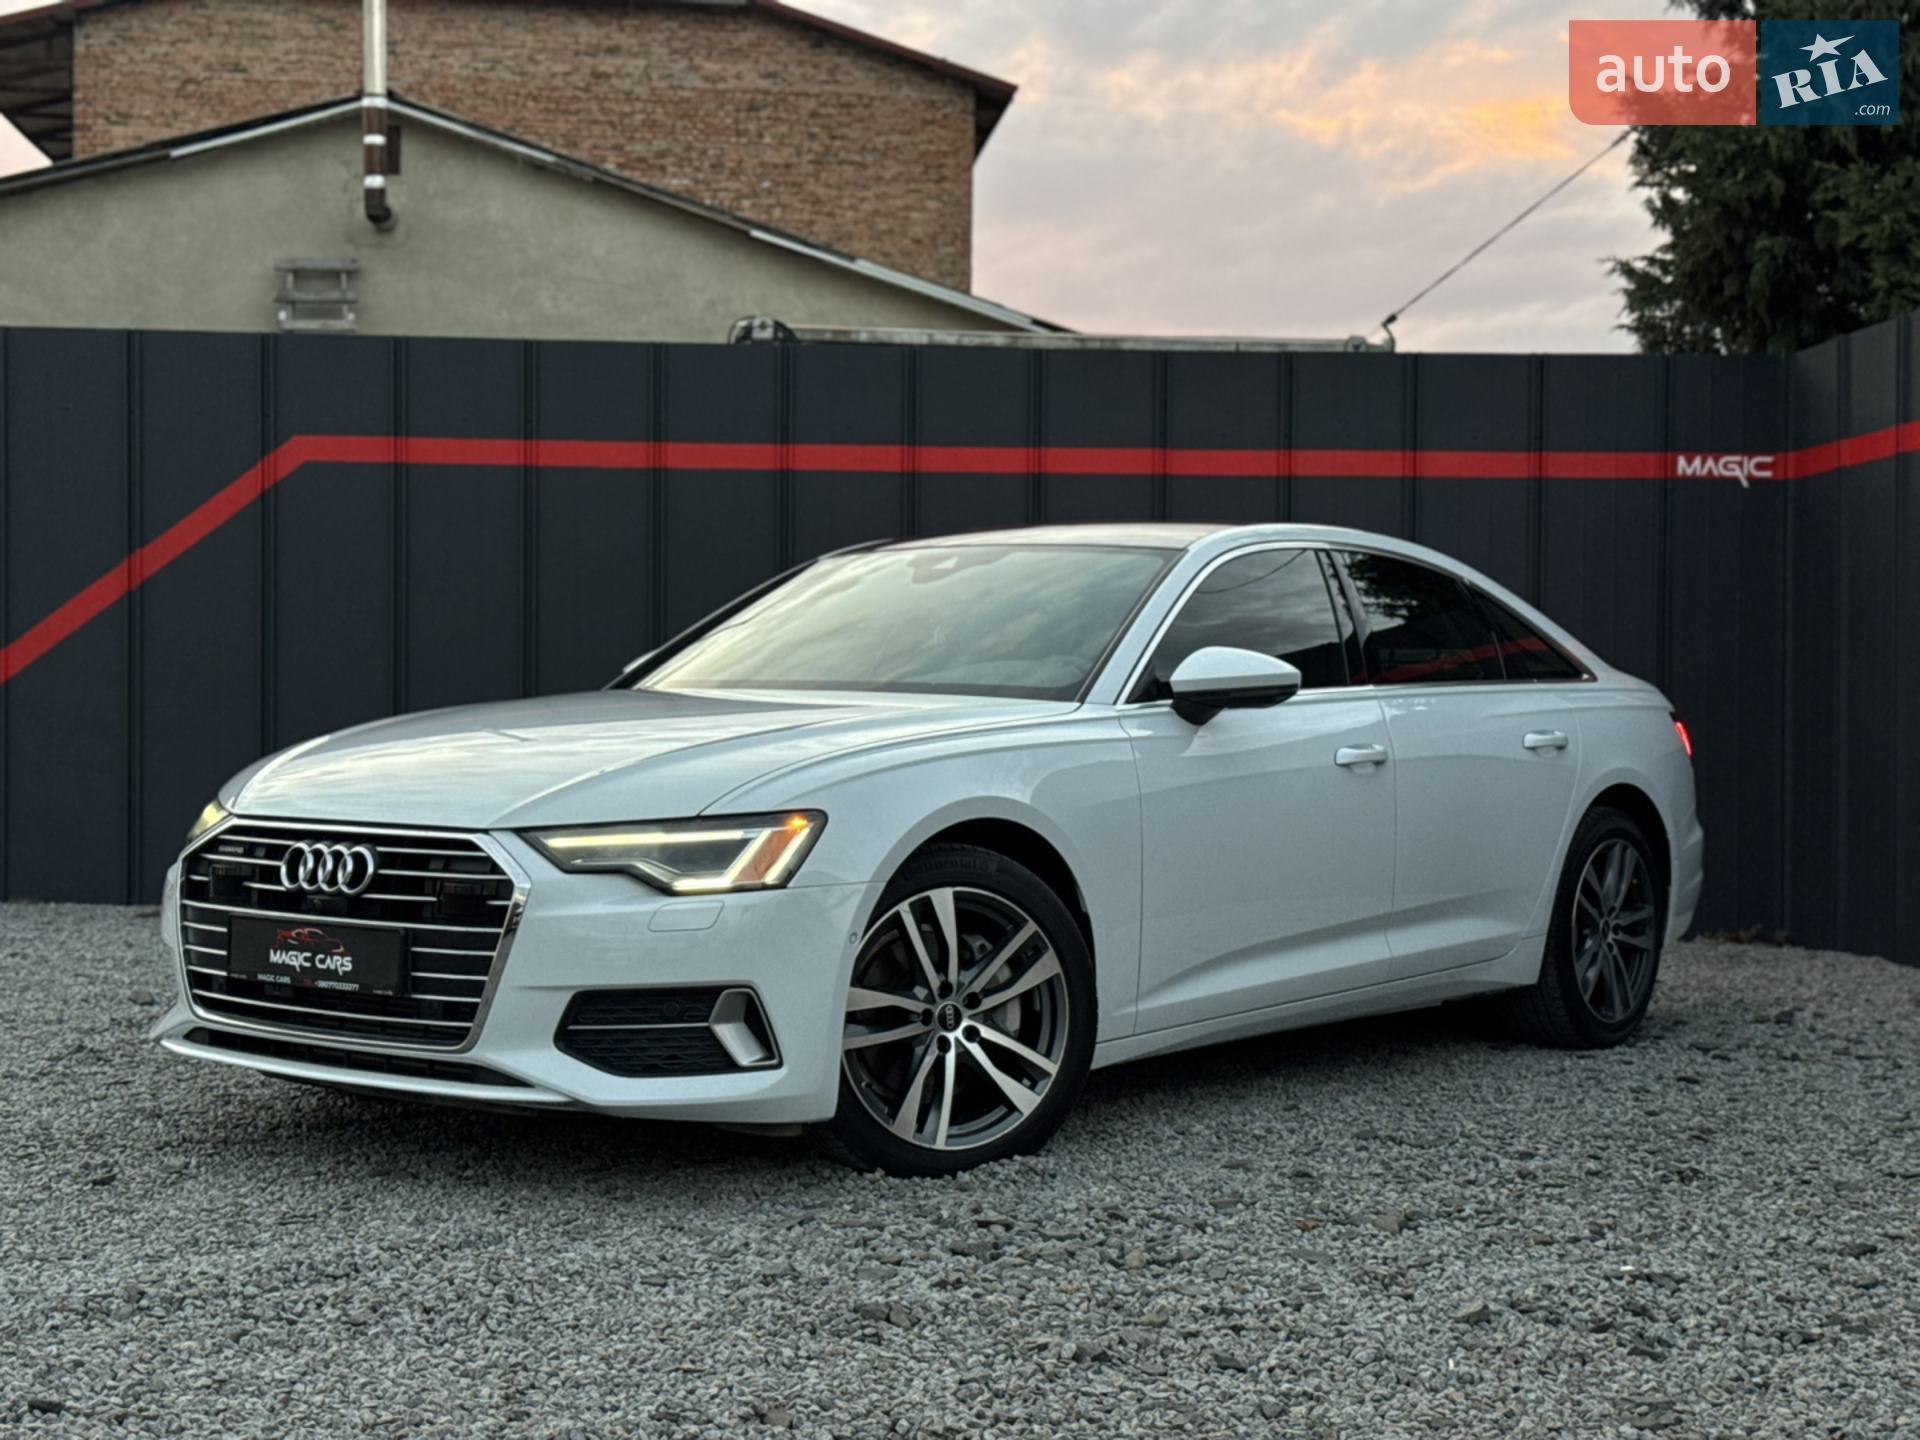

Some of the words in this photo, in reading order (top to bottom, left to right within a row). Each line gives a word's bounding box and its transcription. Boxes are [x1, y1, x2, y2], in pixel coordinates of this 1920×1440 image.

[1676, 454, 1774, 488] MAGIC
[269, 948, 312, 972] MAGIC
[315, 954, 352, 976] CARS
[257, 973, 275, 983] MAGIC
[275, 975, 291, 984] CARS
